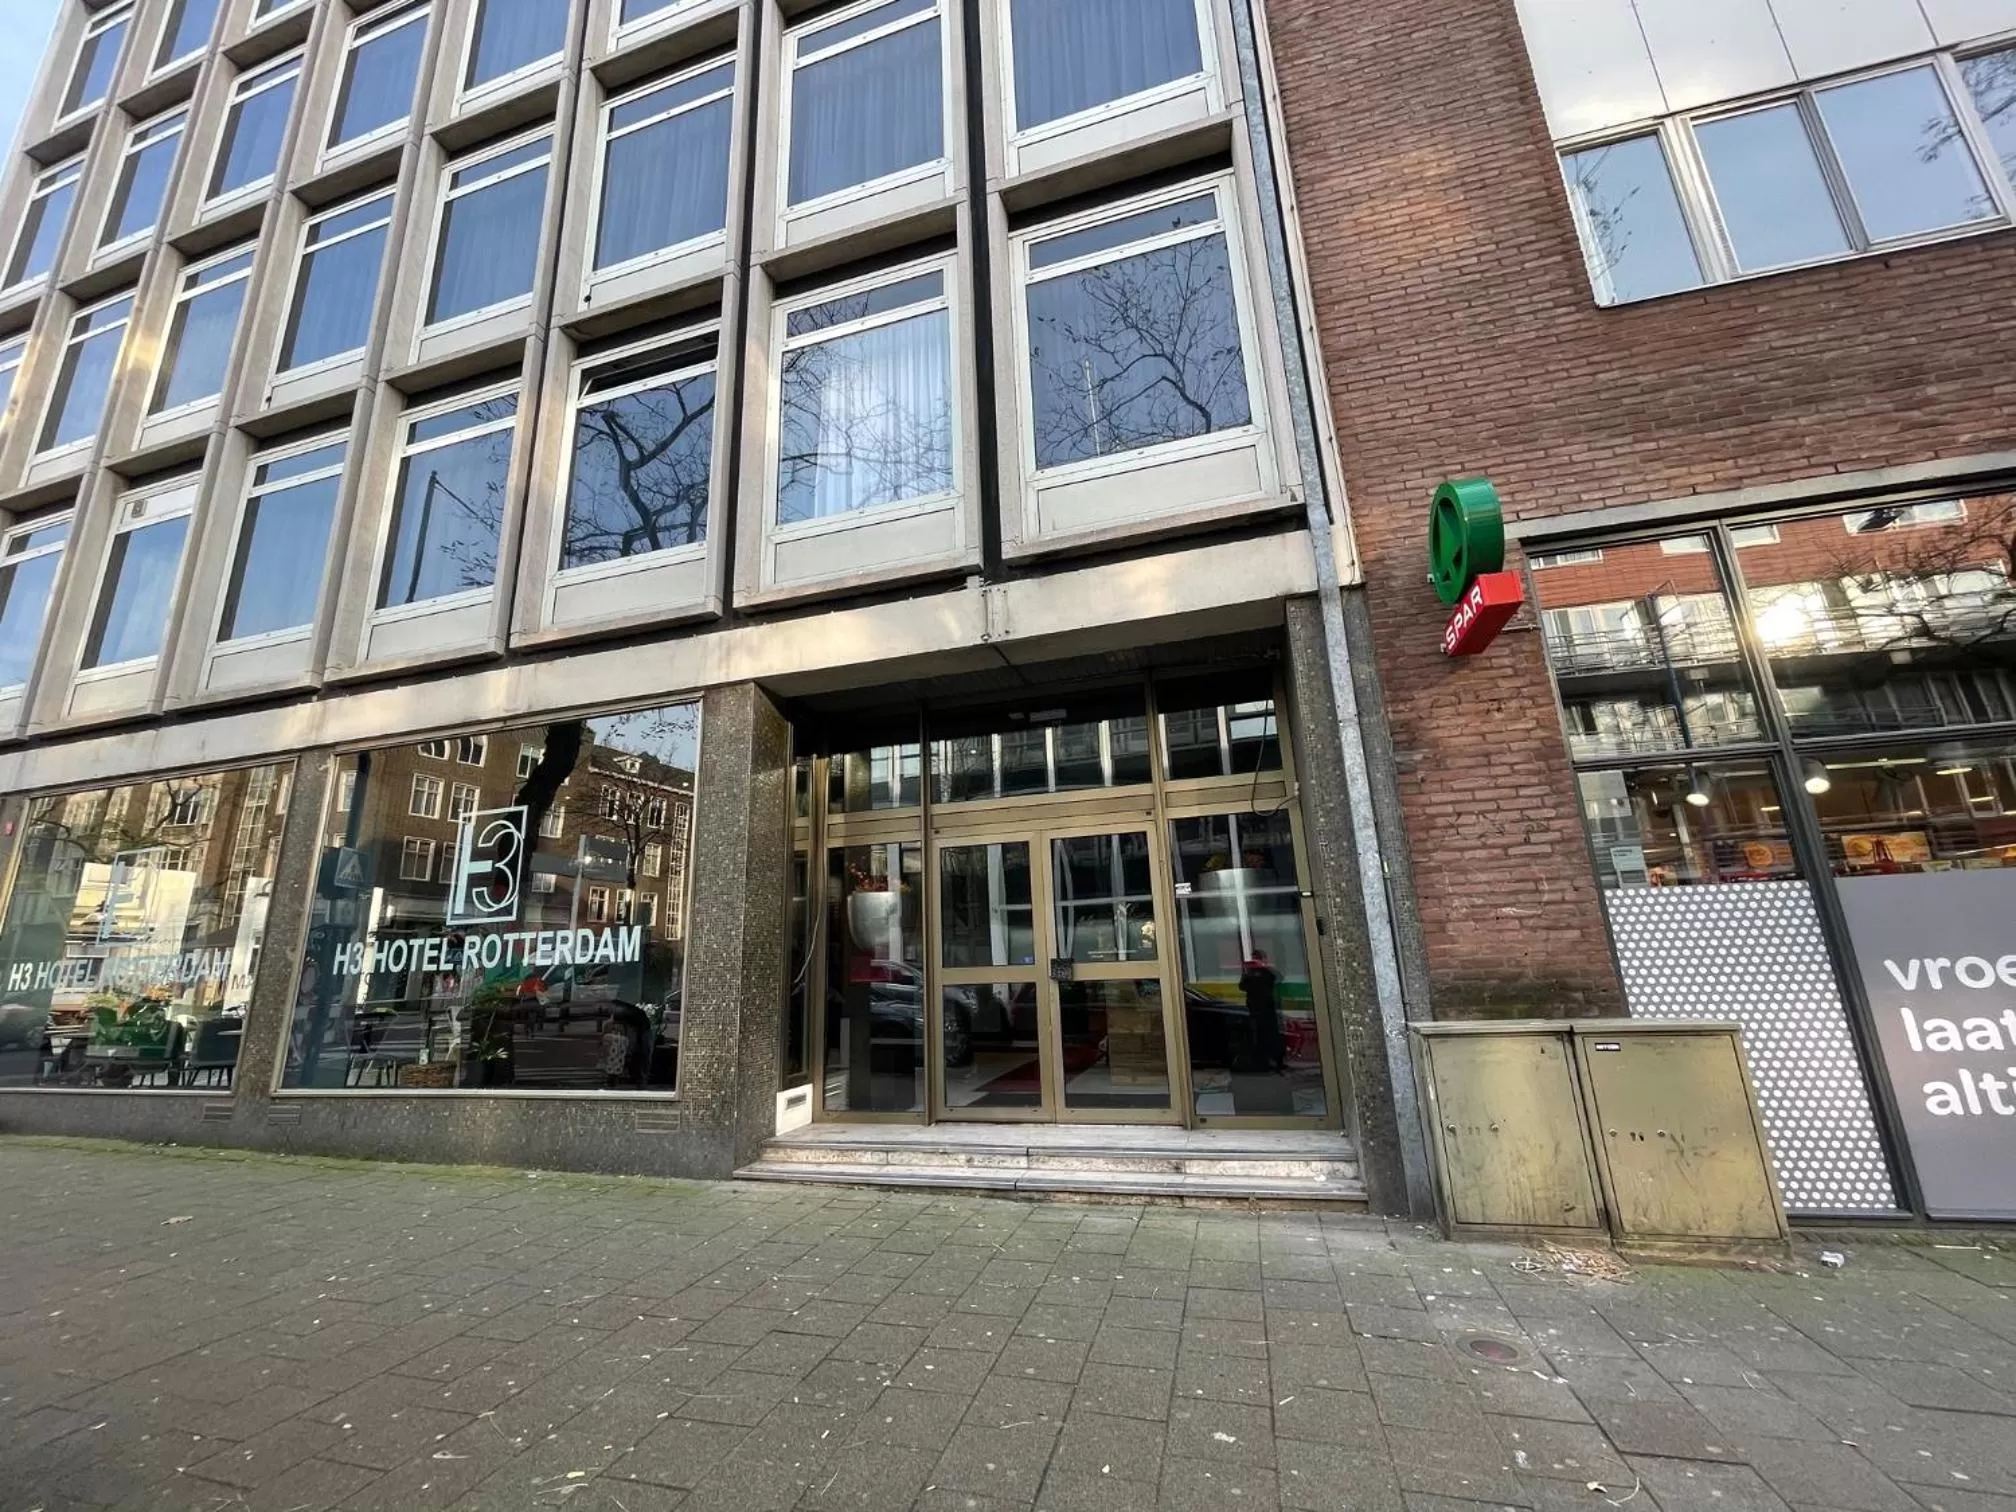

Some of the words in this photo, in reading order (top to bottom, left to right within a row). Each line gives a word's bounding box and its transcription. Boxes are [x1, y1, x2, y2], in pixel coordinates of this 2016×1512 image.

[1446, 584, 1483, 650] SPAR
[333, 941, 364, 975] H3
[370, 937, 453, 973] HOTEL
[462, 925, 642, 969] ROTTERDAM
[7, 963, 32, 992] H3
[34, 956, 97, 990] HOTEL
[1883, 954, 2016, 991] vroe
